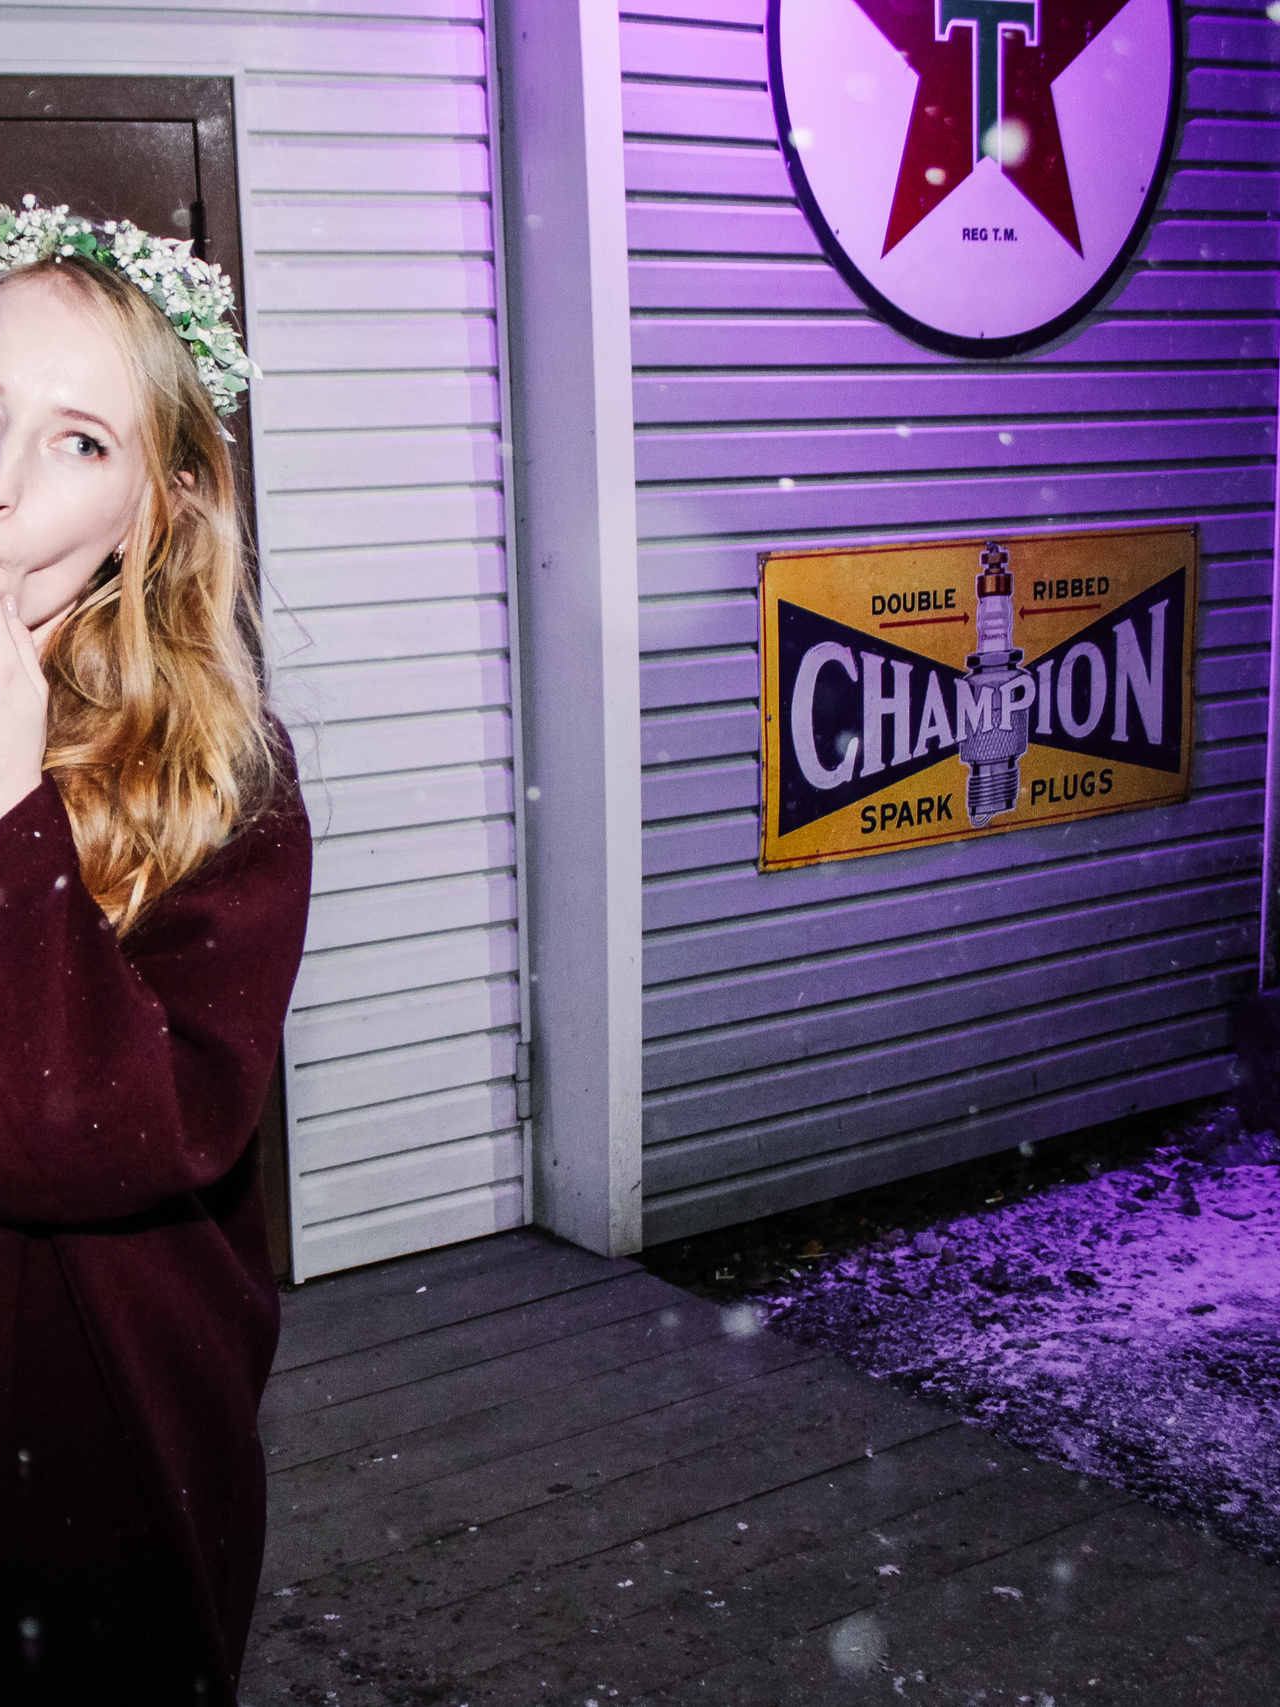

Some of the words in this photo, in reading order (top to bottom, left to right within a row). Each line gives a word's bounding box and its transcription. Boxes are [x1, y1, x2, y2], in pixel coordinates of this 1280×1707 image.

[935, 0, 1040, 172] T
[962, 227, 988, 241] REG
[992, 227, 1018, 241] T.M.
[871, 588, 957, 616] DOUBLE
[1032, 576, 1110, 601] RIBBED
[791, 598, 1169, 790] CHAMPION
[860, 793, 954, 834] SPARK
[1031, 768, 1114, 806] PLUGS
